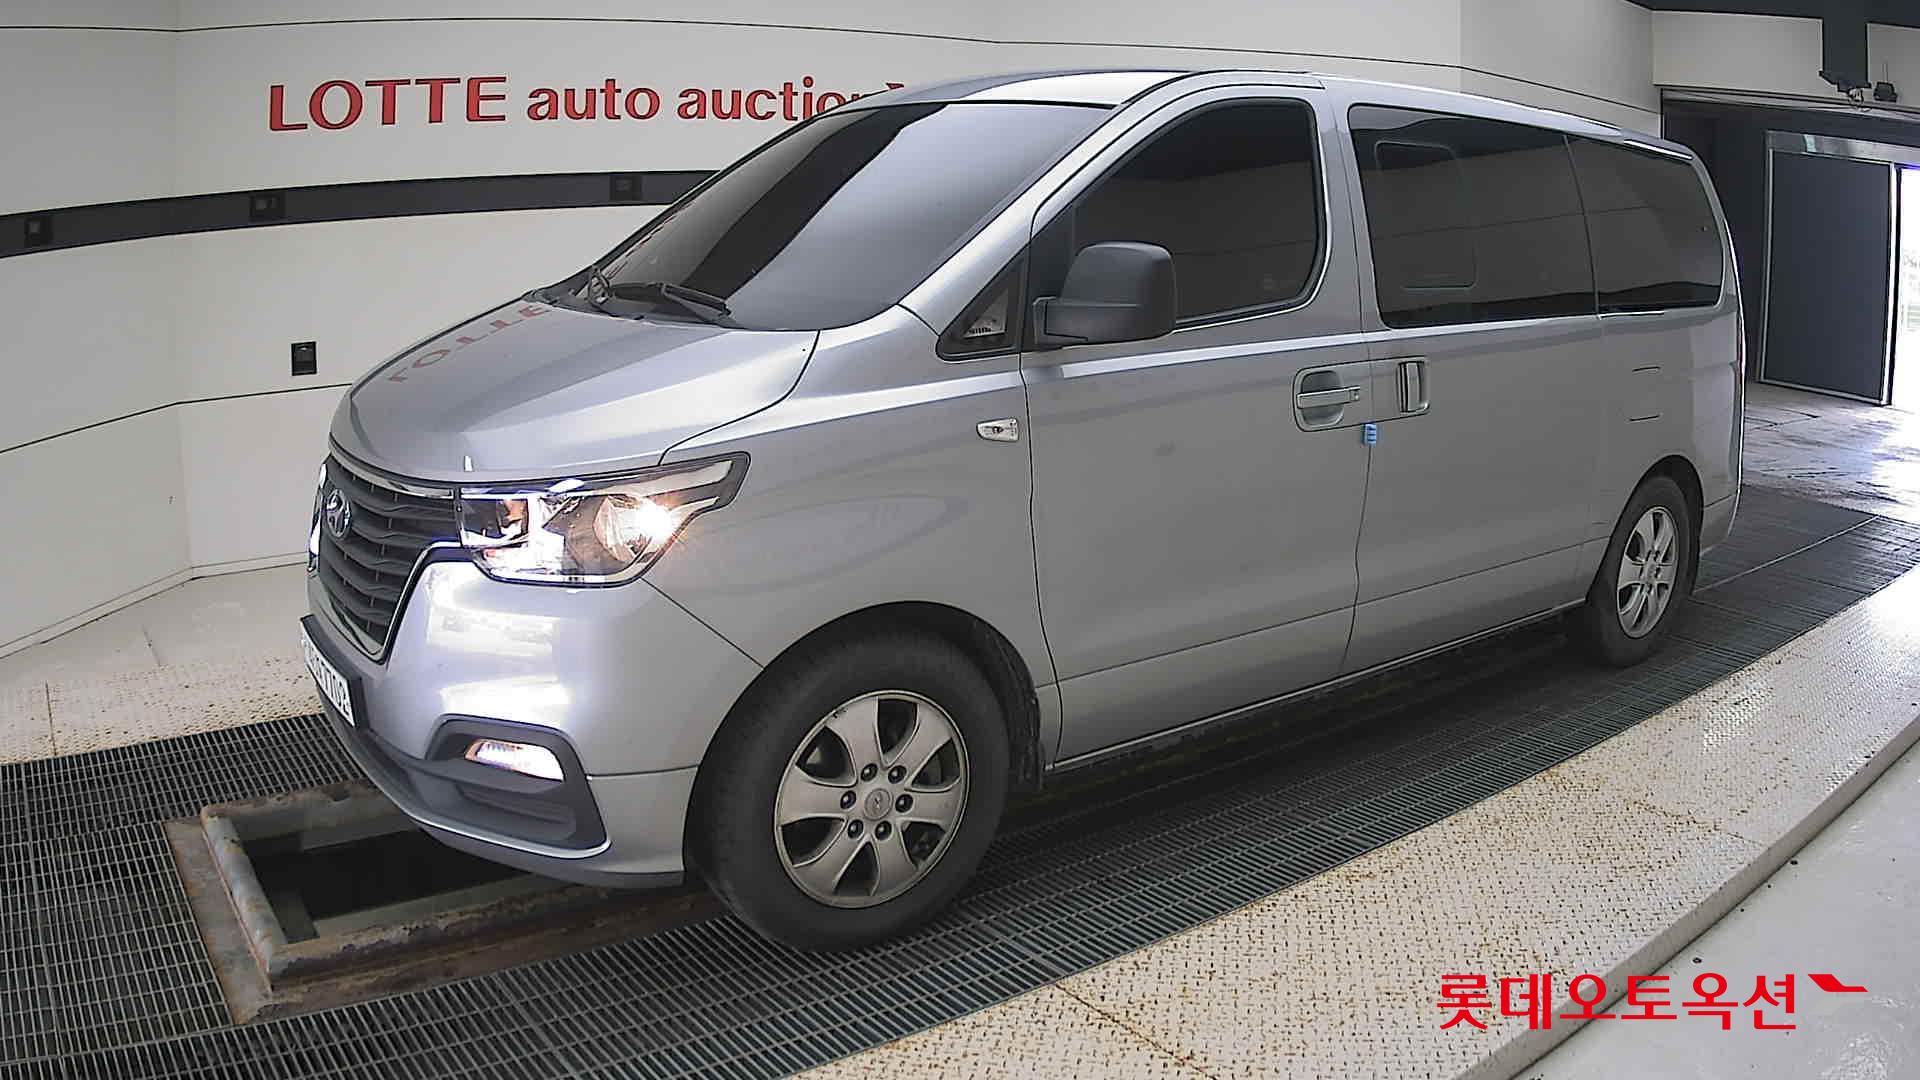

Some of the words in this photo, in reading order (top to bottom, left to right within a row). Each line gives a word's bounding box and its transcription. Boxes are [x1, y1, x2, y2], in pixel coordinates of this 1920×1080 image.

[268, 75, 507, 131] LOTTE
[526, 79, 664, 122] auto
[677, 75, 867, 122] auctio
